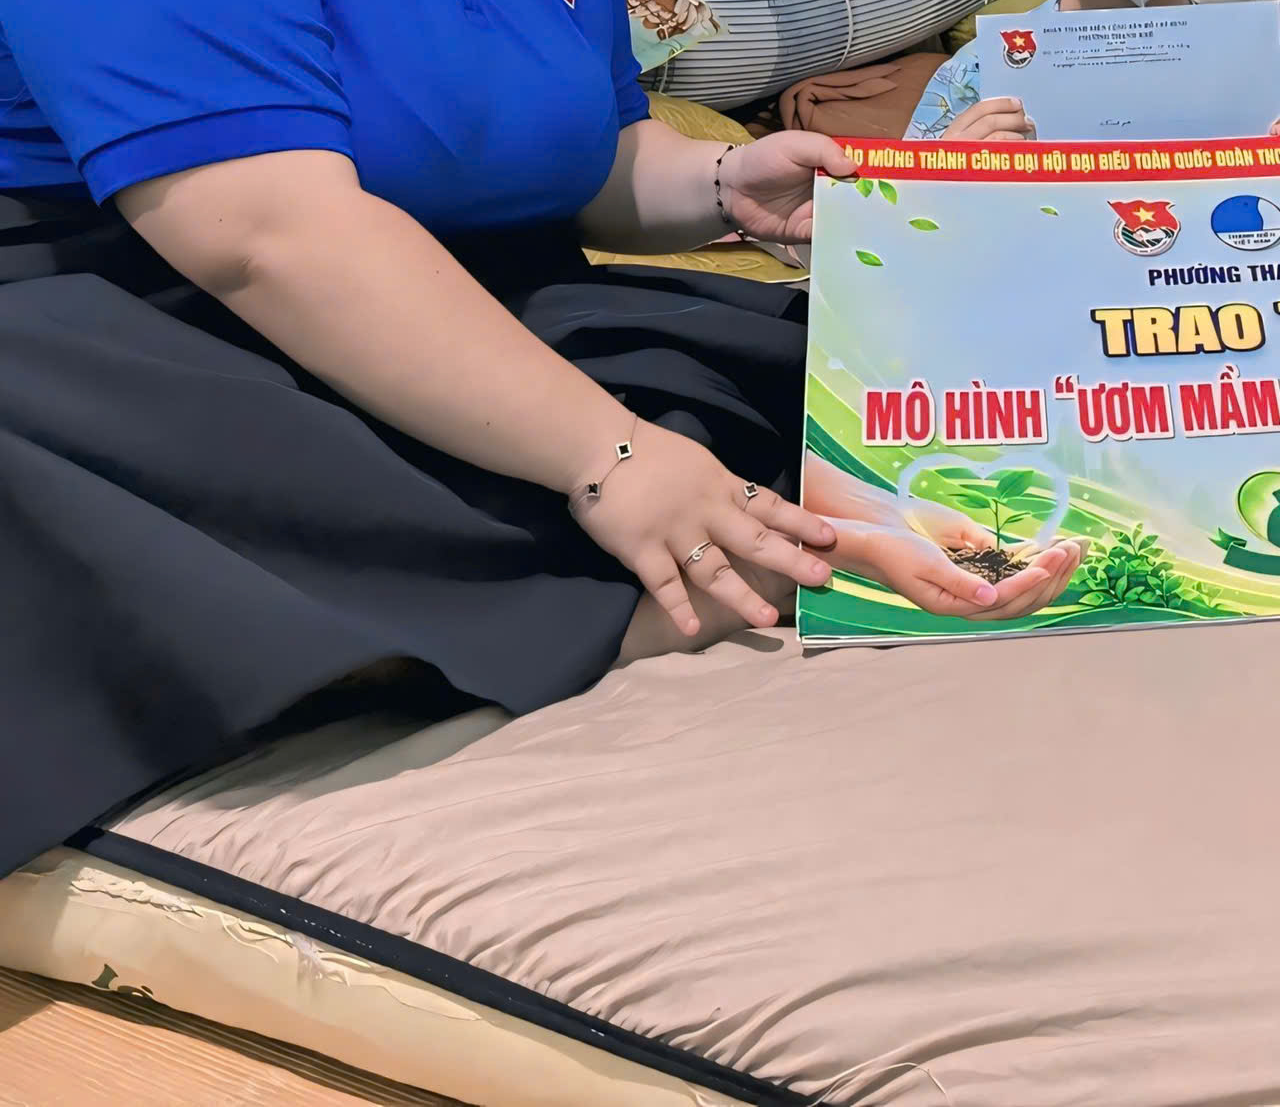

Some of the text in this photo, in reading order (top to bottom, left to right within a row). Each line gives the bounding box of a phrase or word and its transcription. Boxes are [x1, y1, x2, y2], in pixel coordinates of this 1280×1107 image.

[844, 144, 864, 166] ÀO
[868, 147, 914, 168] MỪNG
[919, 149, 967, 170] THÀNH
[971, 149, 1010, 171] CÔNG
[1043, 150, 1067, 173] HỘI
[1134, 149, 1171, 170] TOÀN
[1174, 148, 1212, 169] QUỐC
[1148, 262, 1241, 287] PHƯỜNG
[1090, 302, 1266, 358] TRAO
[865, 381, 931, 441] MÔ
[945, 380, 1043, 439] HÌNH
